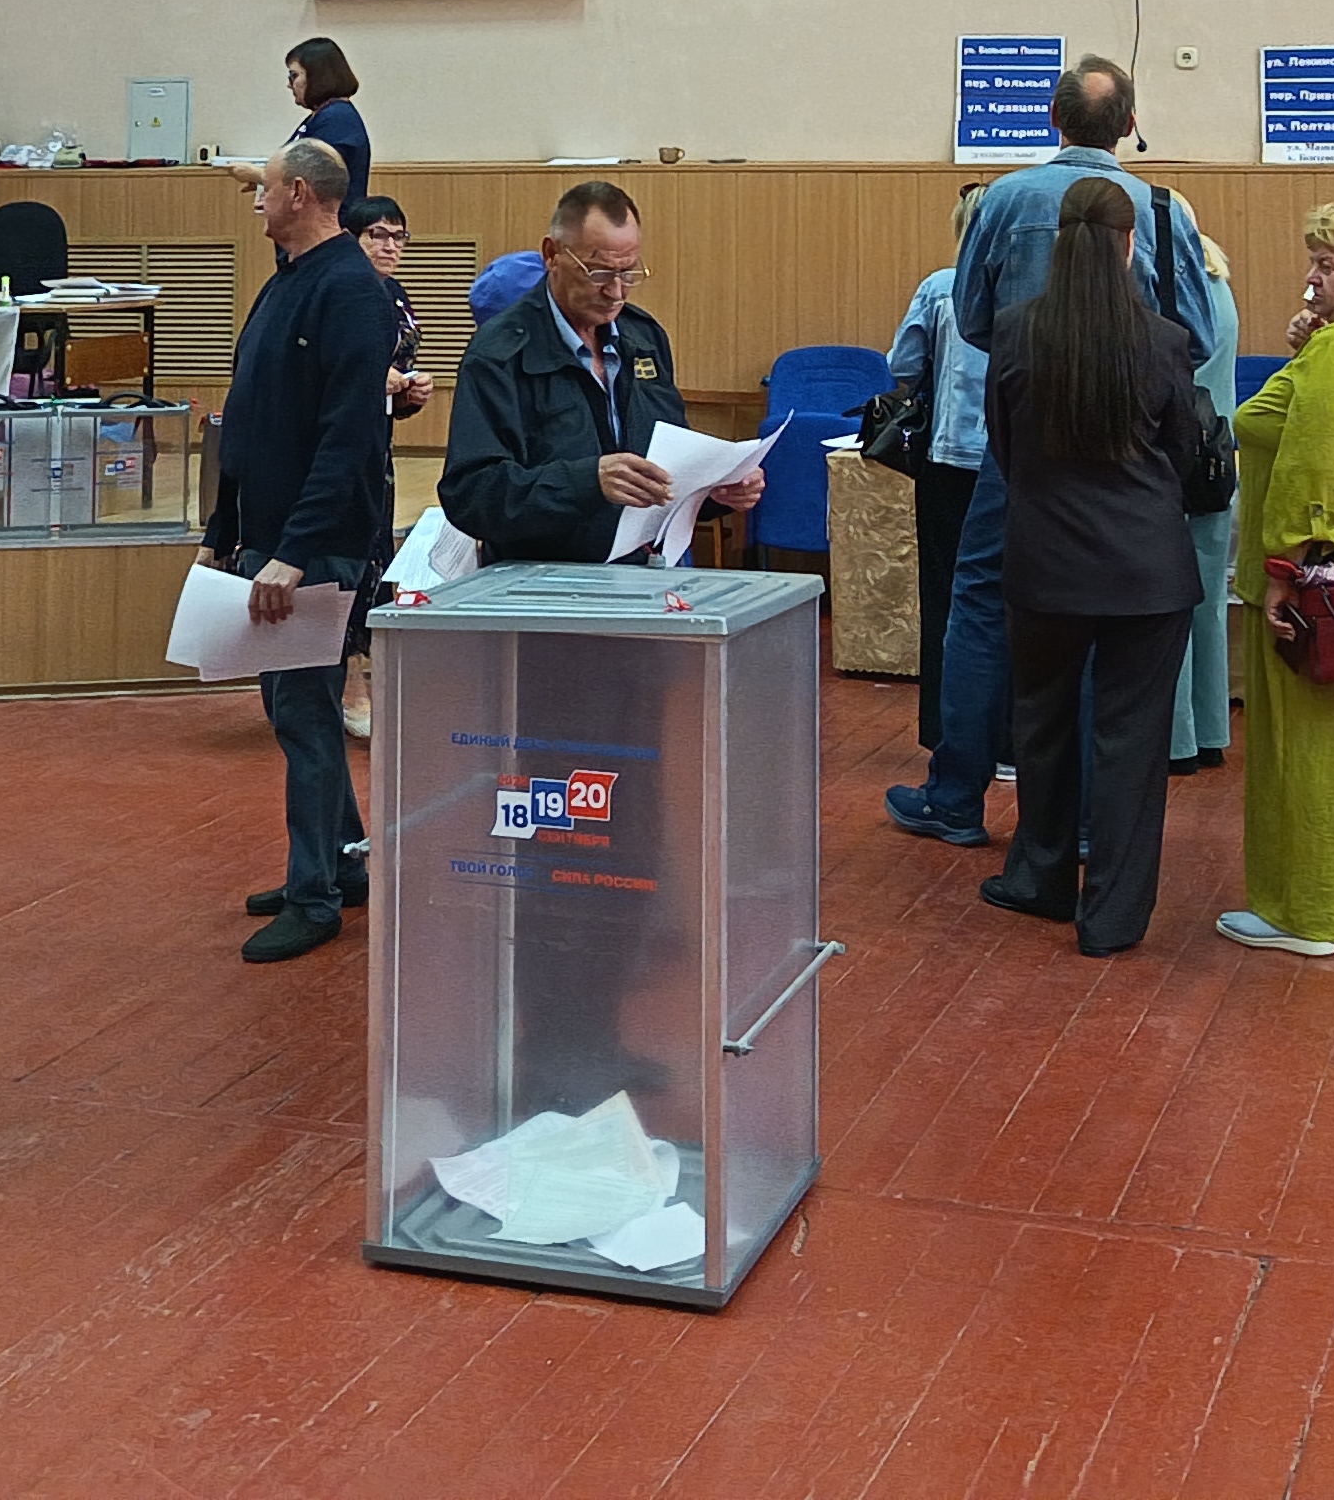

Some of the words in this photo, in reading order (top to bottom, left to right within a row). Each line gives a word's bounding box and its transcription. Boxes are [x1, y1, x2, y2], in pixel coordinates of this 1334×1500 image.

[967, 104, 985, 114] ул.
[988, 102, 1048, 114] Кравцова
[970, 129, 988, 140] ул.
[991, 127, 1049, 139] Гагарина
[1267, 123, 1287, 133] ул.
[451, 733, 511, 749] ЕДИНЫЙ
[501, 804, 529, 828] 18
[535, 791, 564, 818] 19
[570, 781, 607, 809] 20
[451, 859, 487, 874] ТВОЙ
[552, 869, 590, 884] СИЛА
